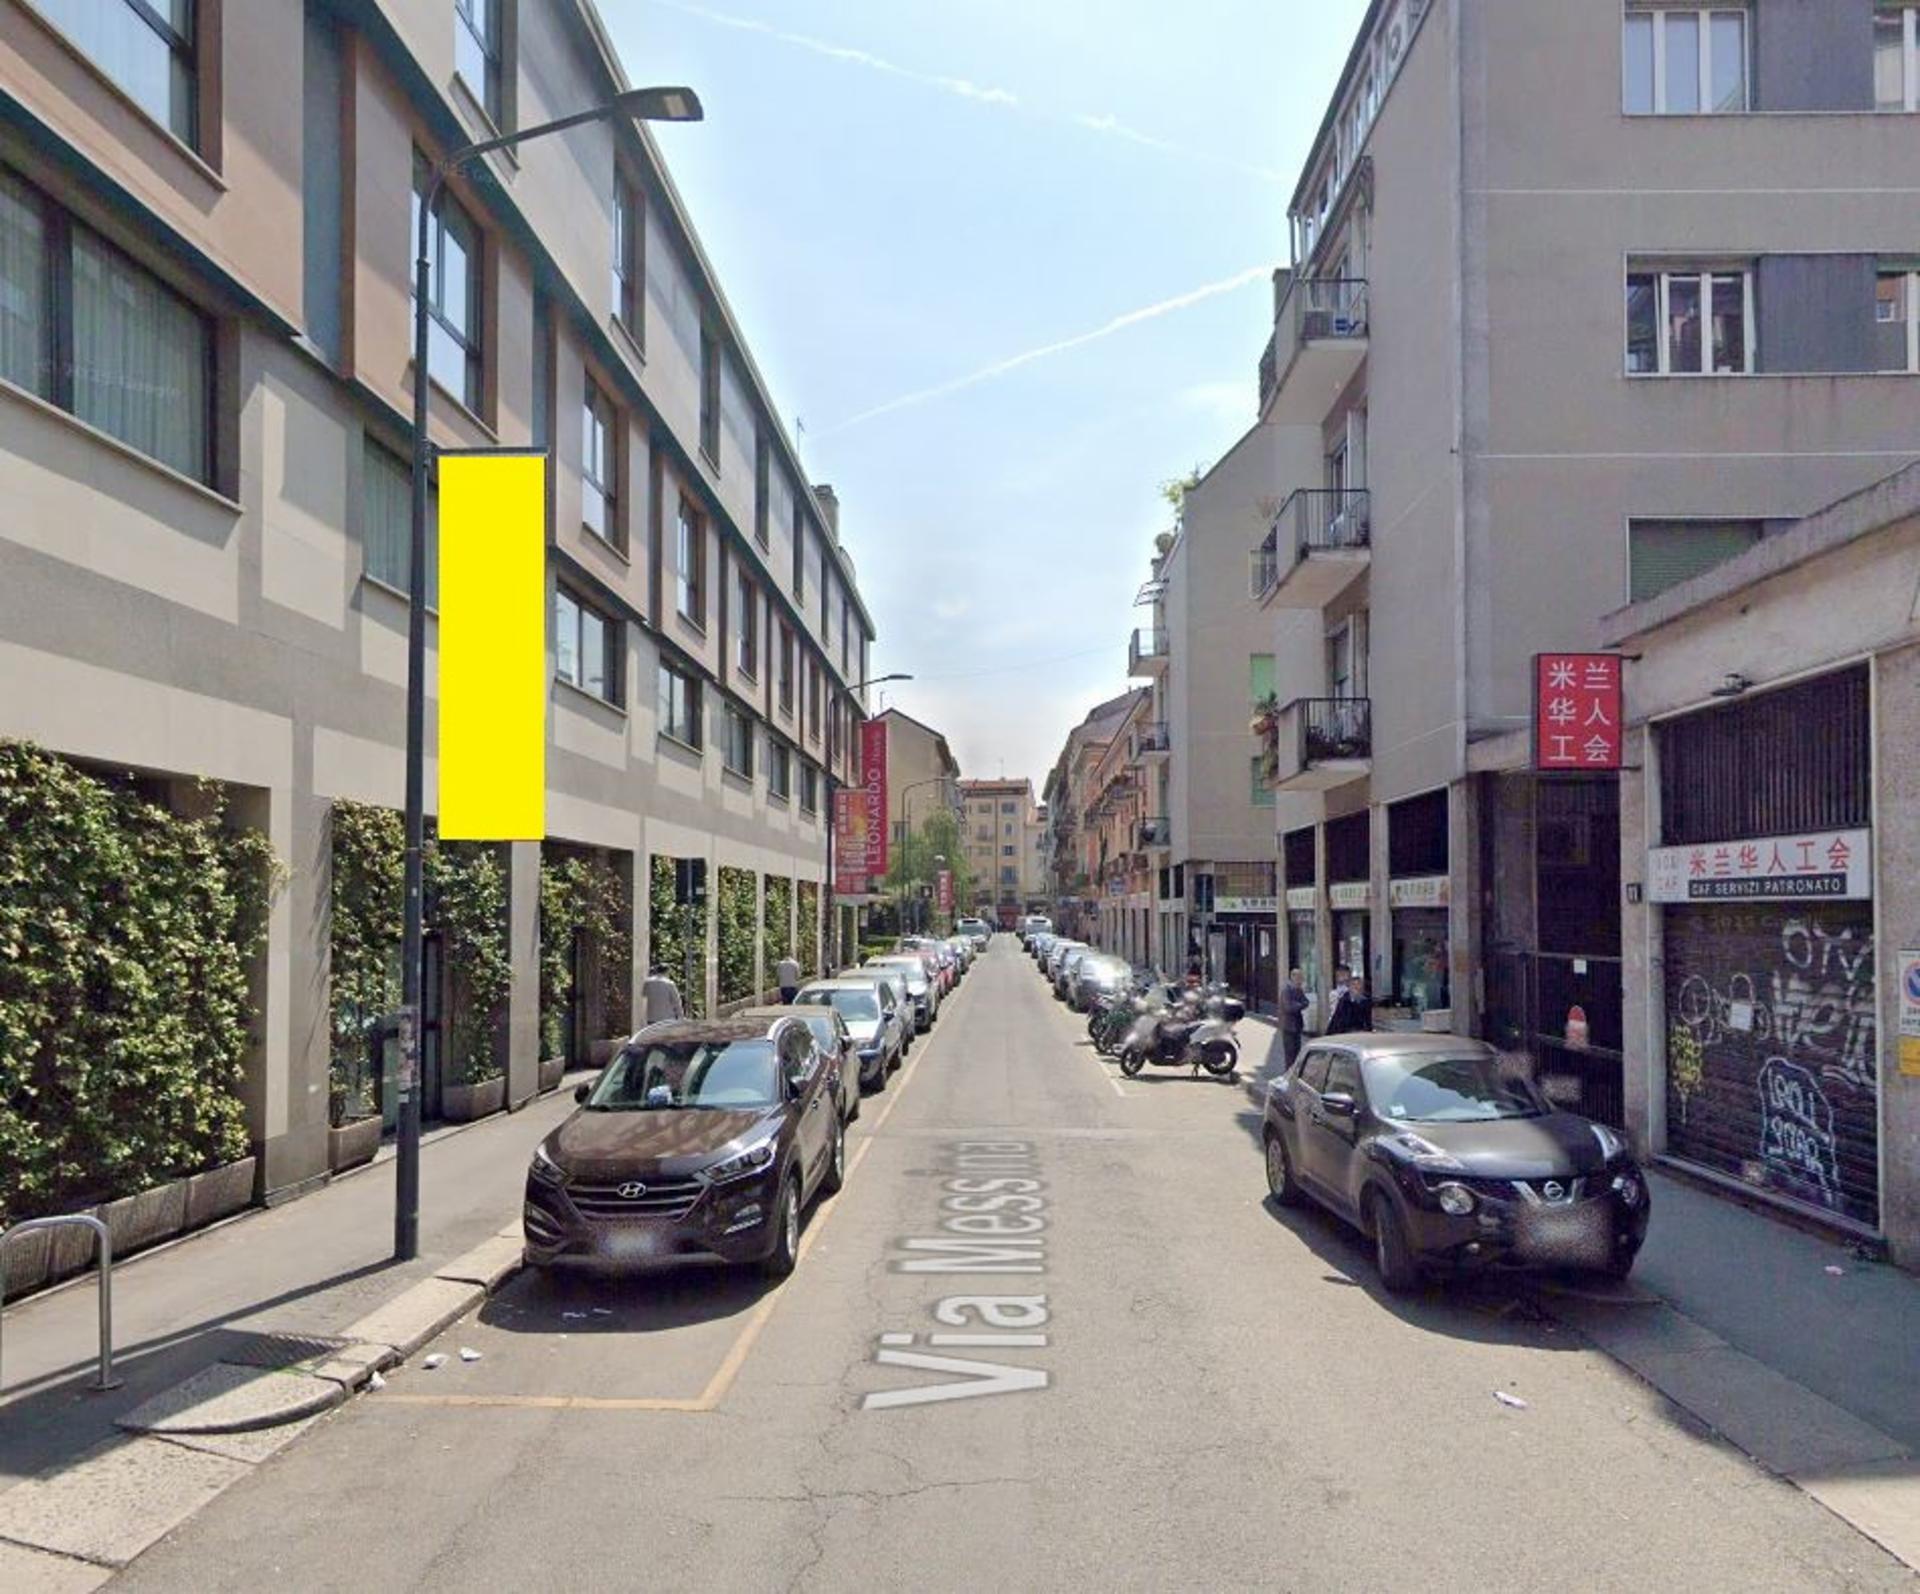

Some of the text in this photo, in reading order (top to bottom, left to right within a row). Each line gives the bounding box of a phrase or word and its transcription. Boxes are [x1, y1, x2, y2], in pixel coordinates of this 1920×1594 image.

[1548, 661, 1611, 690] 米兰
[1548, 698, 1611, 726] 华人
[1548, 735, 1611, 763] 工会
[867, 768, 882, 866] LEONARDO
[1689, 836, 1851, 877] 米兰华人工会
[1714, 880, 1760, 895] SERVIZI
[1764, 877, 1841, 893] PATRONATO
